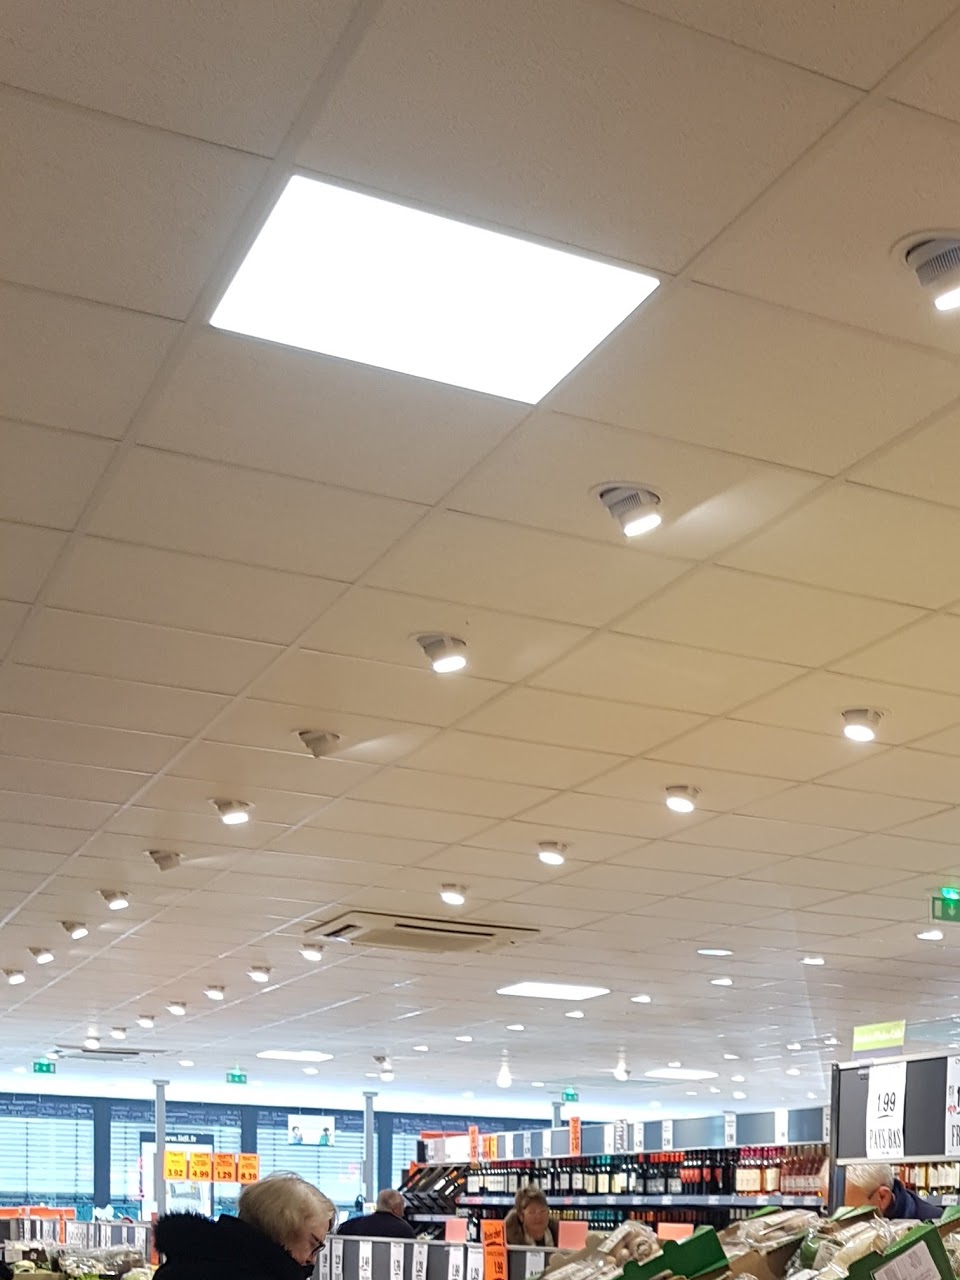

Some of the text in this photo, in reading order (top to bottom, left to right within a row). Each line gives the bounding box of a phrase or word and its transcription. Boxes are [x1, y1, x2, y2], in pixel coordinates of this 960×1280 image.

[877, 1092, 896, 1112] 1.99
[165, 1134, 197, 1143] ww.lidl.fr
[192, 1170, 209, 1179] 4.99
